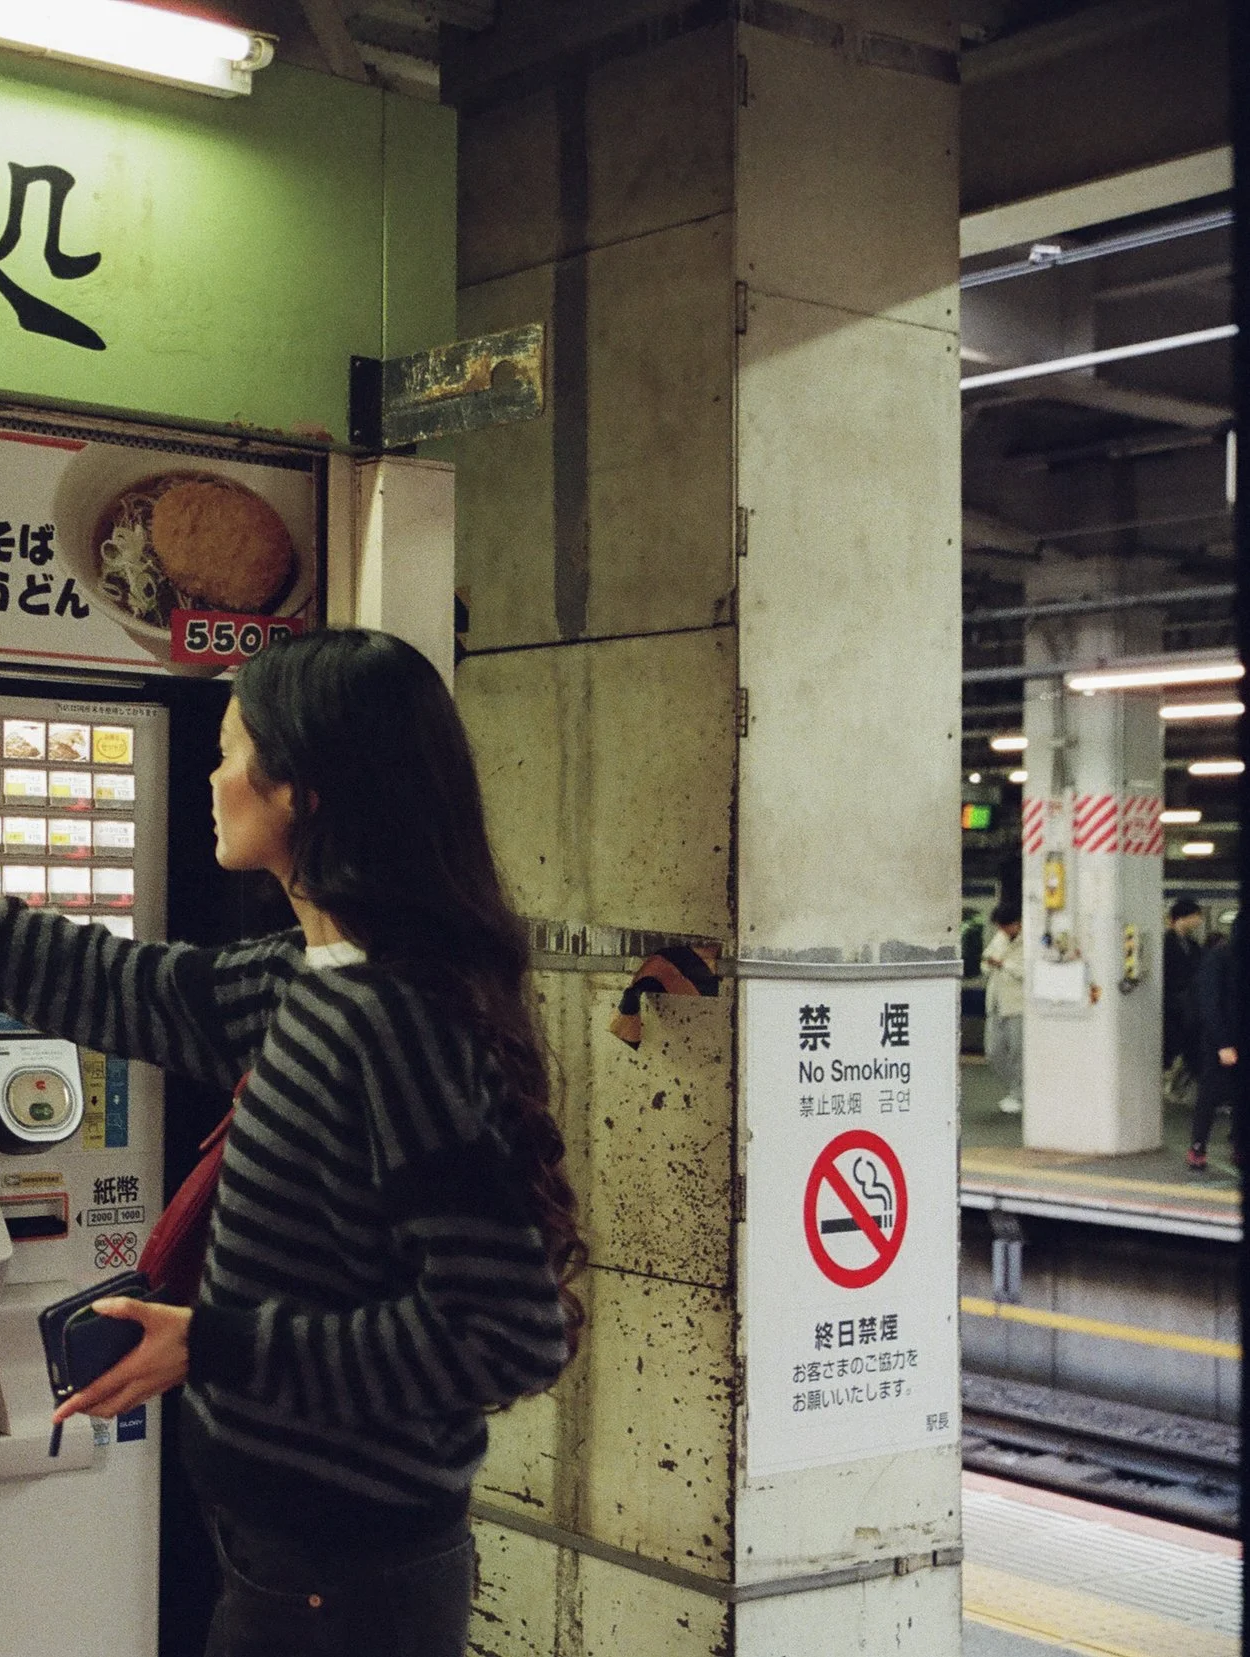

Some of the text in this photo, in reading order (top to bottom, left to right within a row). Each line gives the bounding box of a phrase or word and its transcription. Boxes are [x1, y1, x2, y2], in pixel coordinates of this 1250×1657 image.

[799, 1057, 911, 1084] No Smoking
[800, 1091, 862, 1118] 禁止吸烟
[879, 1088, 911, 1115] 금연
[92, 1175, 140, 1206] 紙幣
[91, 1209, 140, 1223] 2000 1000
[814, 1314, 898, 1351] 終日禁煙
[793, 1349, 918, 1383] お客さまのご協力を
[792, 1379, 912, 1412] お願いいたします。
